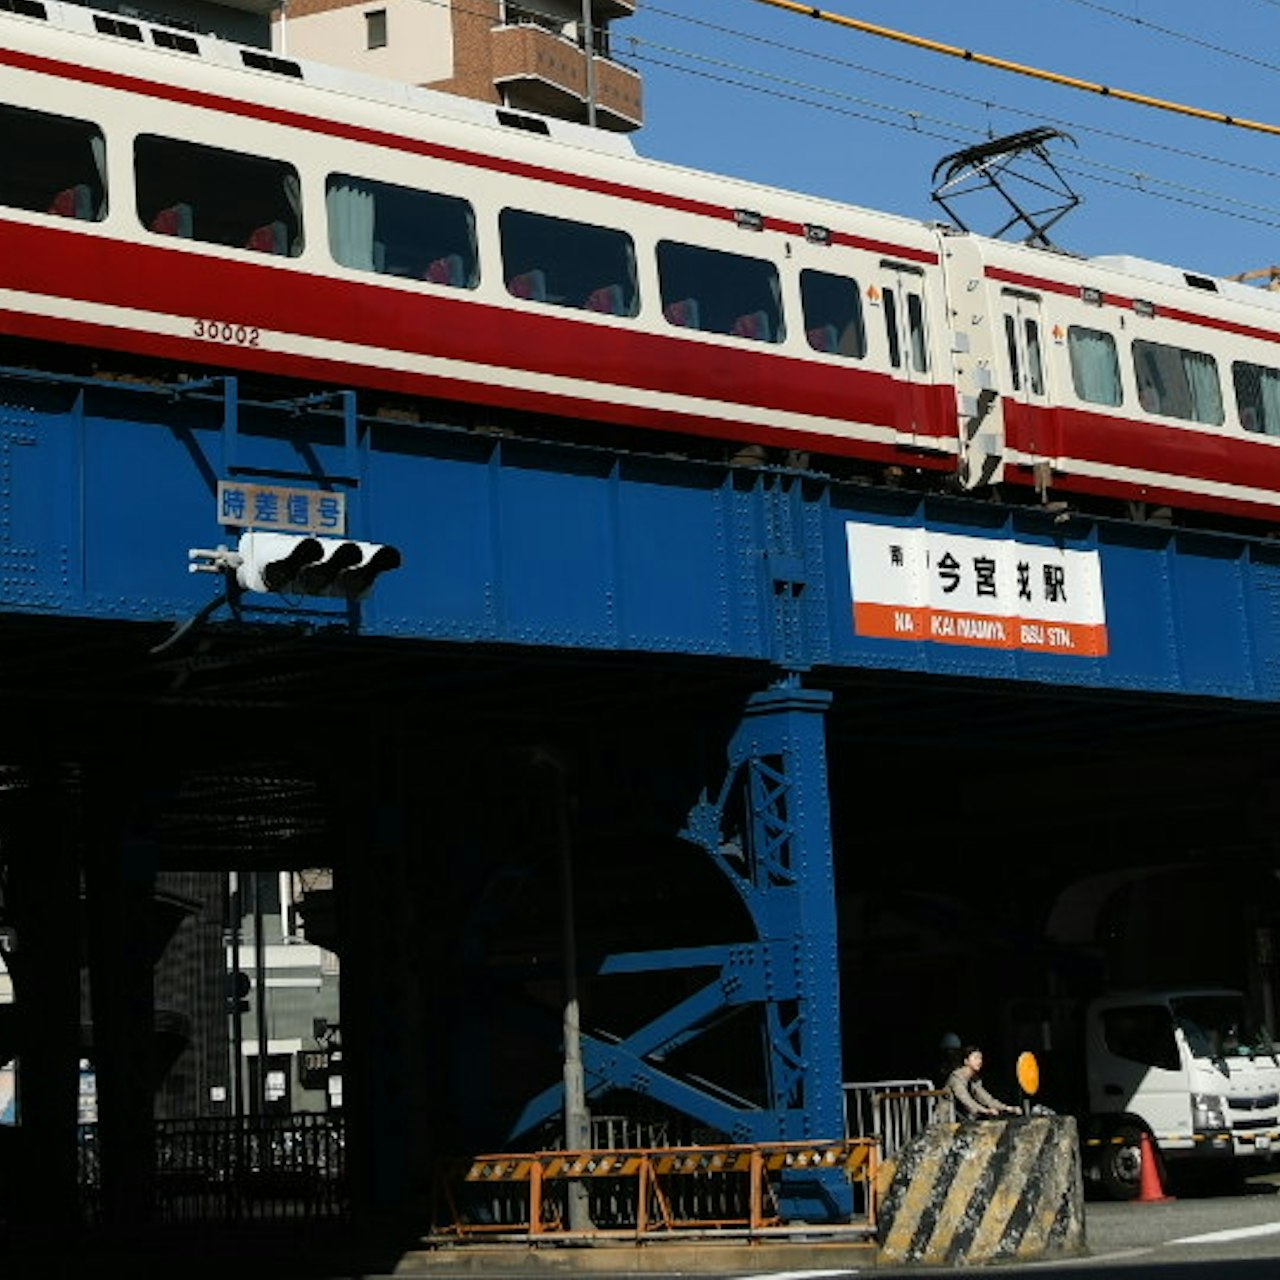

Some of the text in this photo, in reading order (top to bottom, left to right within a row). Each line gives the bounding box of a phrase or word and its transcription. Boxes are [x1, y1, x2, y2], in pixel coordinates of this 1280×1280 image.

[194, 321, 260, 347] 30002
[223, 489, 341, 528] 時差信号
